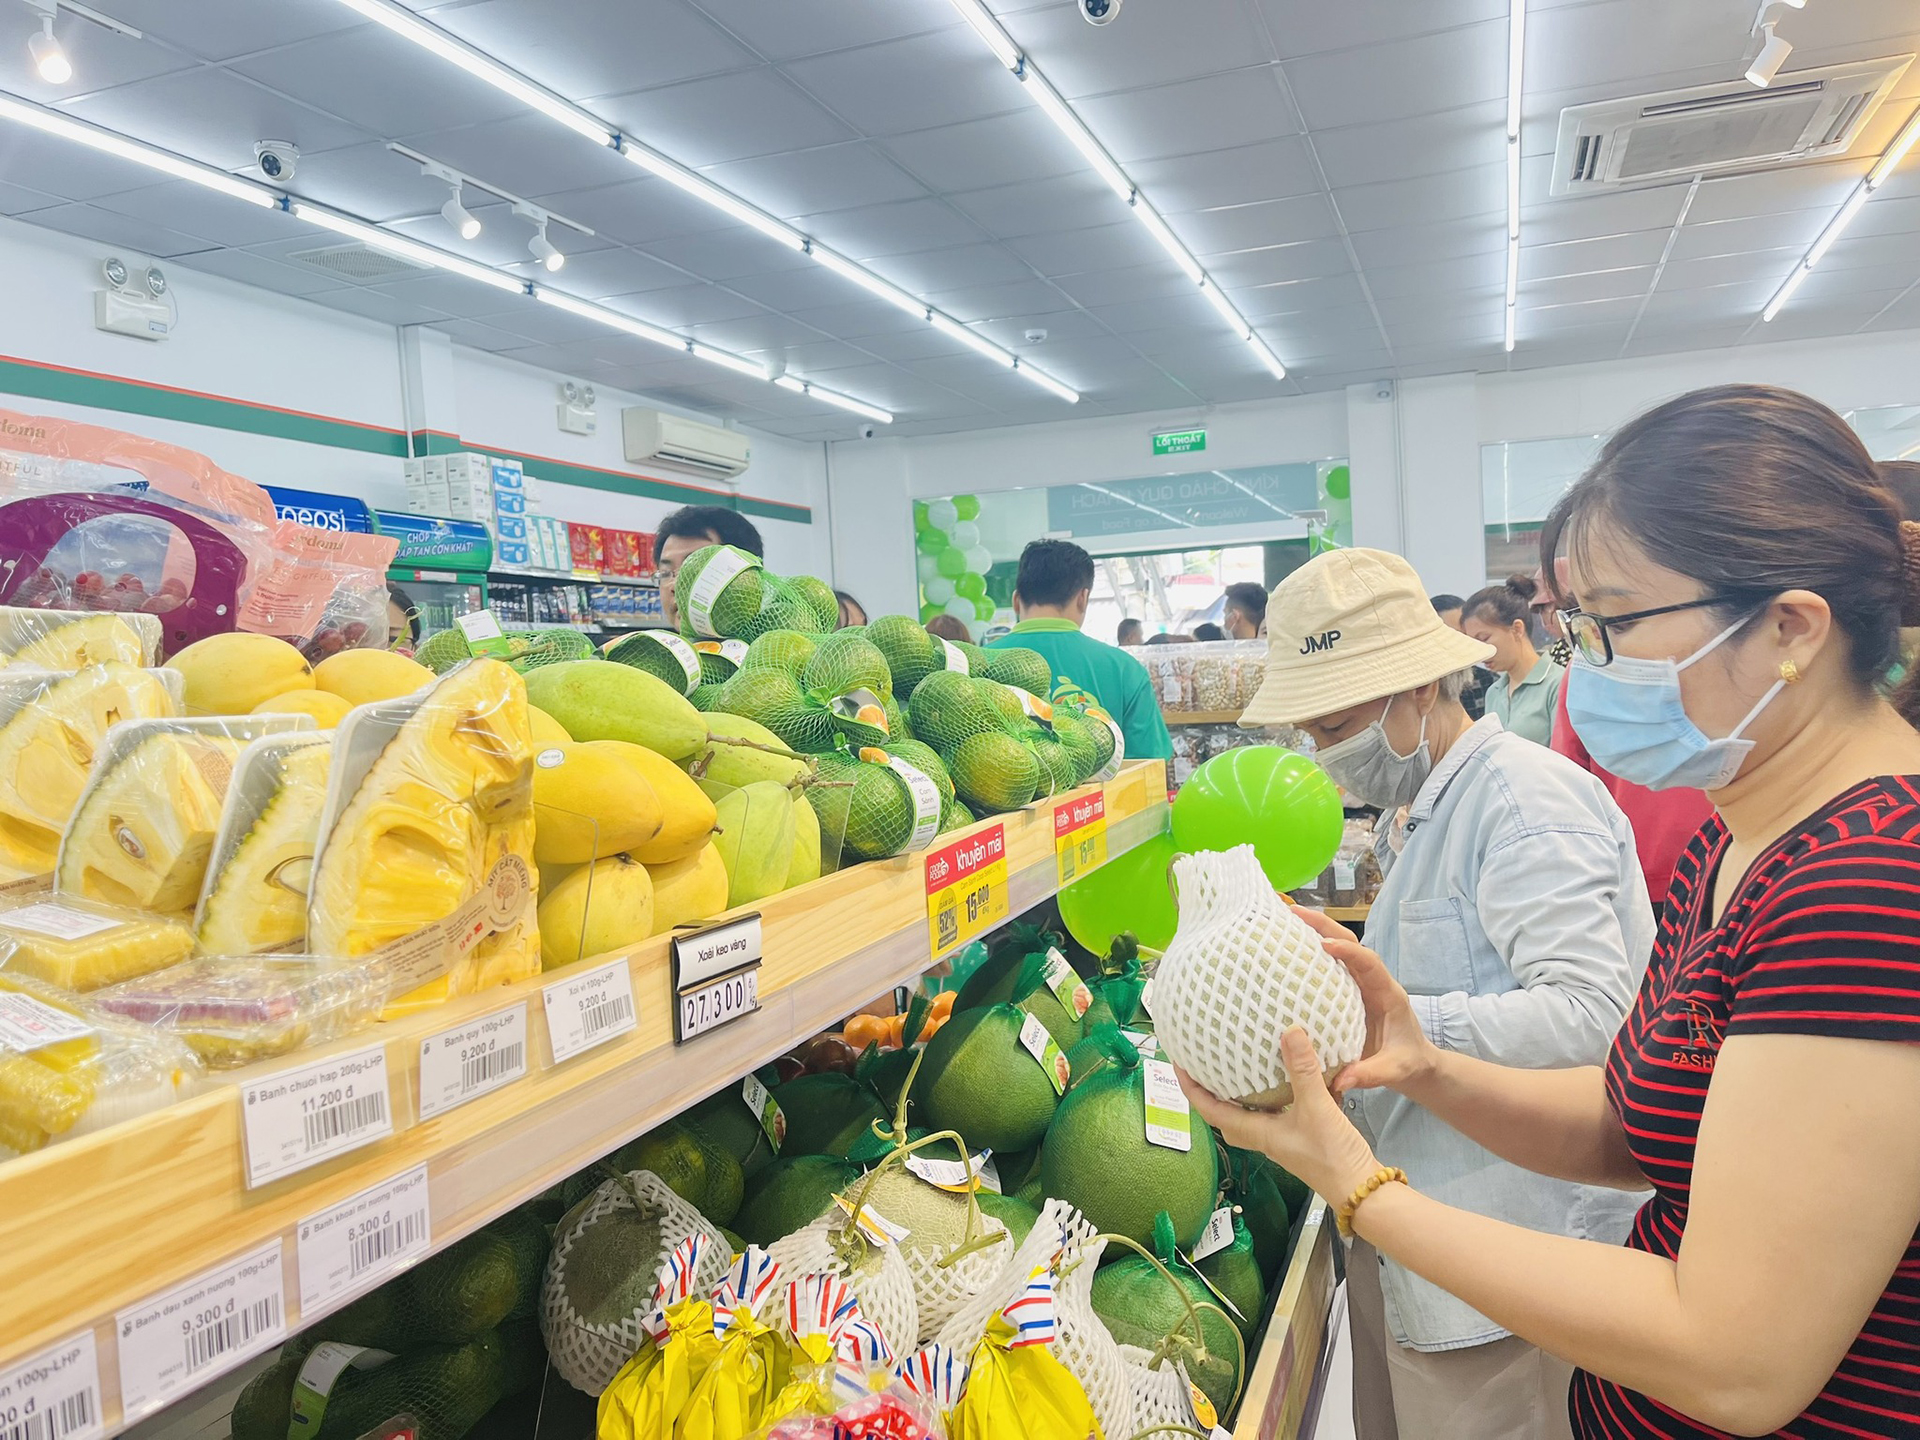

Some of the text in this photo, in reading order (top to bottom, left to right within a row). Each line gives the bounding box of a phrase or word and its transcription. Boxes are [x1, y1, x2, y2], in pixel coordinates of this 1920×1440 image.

[1168, 444, 1191, 452] EXIT
[1299, 630, 1341, 655] JMP
[698, 938, 747, 963] Xoài keo vàng
[578, 990, 607, 1011] 9,200 đ
[444, 1014, 515, 1048] Banh quy 100g-LHP
[460, 1038, 496, 1062] 9,200 đ
[259, 1054, 384, 1102] Banh chuoi hap 200g-LHP
[1153, 1073, 1178, 1087] Select
[301, 1084, 355, 1113] 11,200 đ
[313, 1217, 335, 1234] Banh
[335, 1206, 357, 1223] khoai
[356, 1200, 368, 1212] mi
[348, 1209, 392, 1242] 8,300 đ
[1211, 1218, 1221, 1243] Select
[135, 1311, 161, 1330] Banh
[182, 1290, 206, 1307] xanh
[206, 1273, 237, 1297] nuong
[236, 1252, 279, 1282] 100g-LHP
[181, 1297, 236, 1336] 9,300 đ
[16, 1348, 81, 1391] 100g-LHP
[24, 1396, 36, 1416] đ
